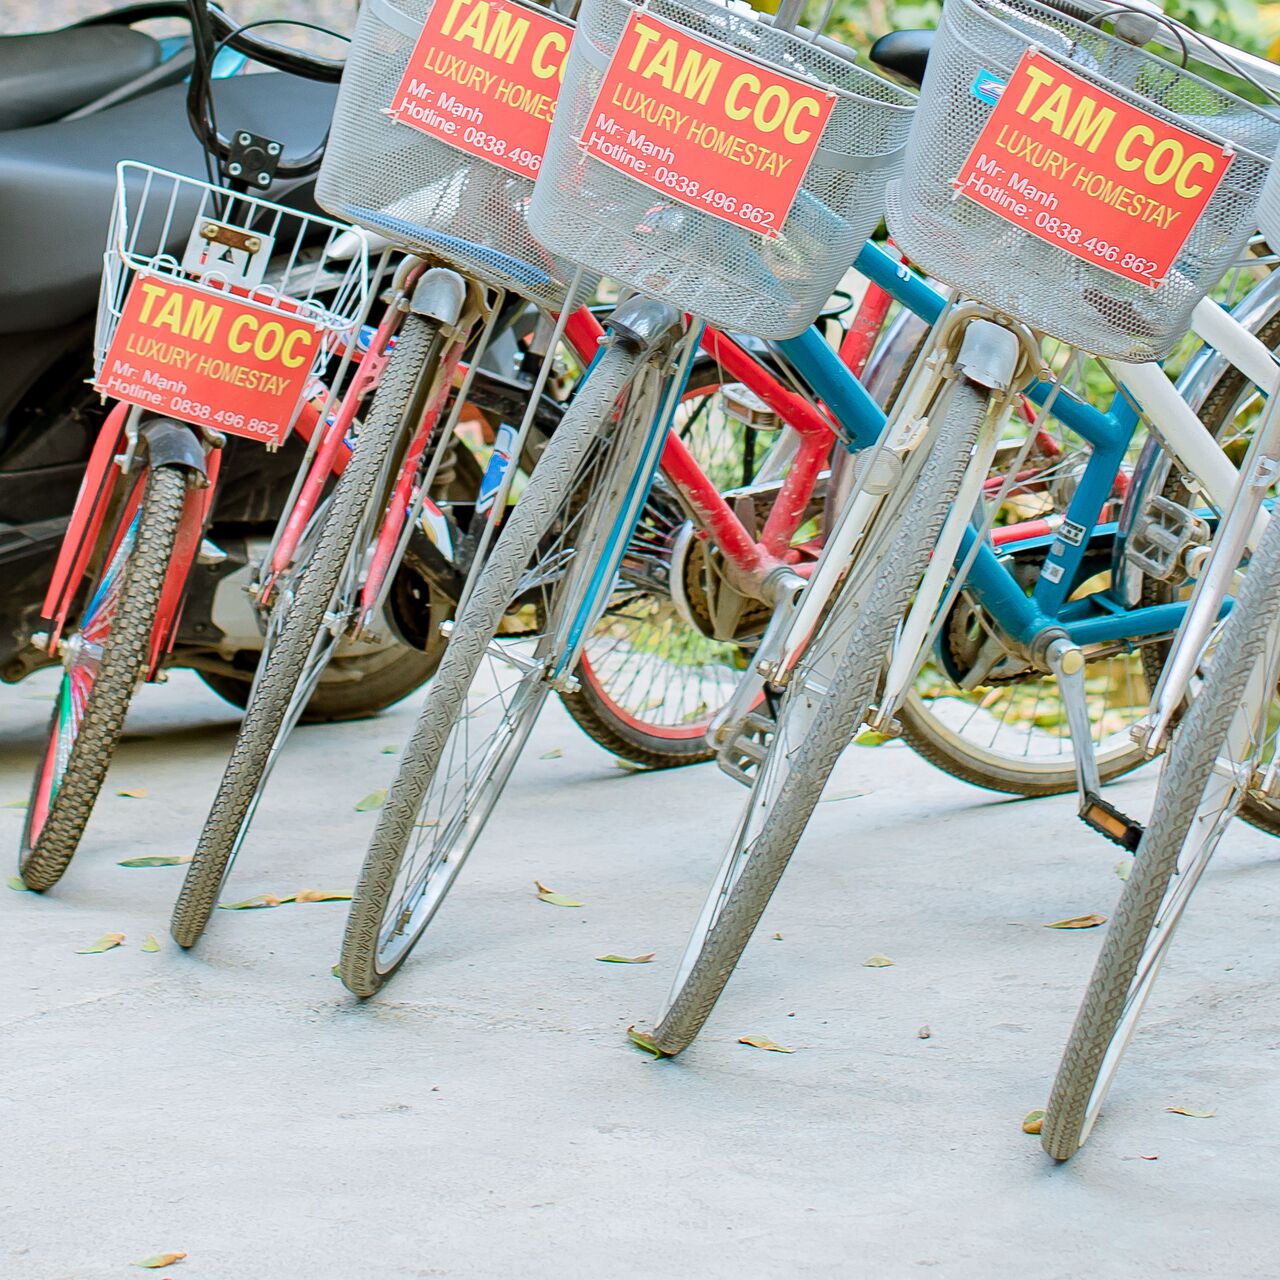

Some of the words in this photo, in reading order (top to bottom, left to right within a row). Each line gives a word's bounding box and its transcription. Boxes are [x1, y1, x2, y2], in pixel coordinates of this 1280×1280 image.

[424, 47, 498, 93] LUXURY
[532, 32, 571, 87] C
[628, 23, 722, 105] TAM
[725, 74, 820, 144] COC
[400, 98, 460, 136] Hotline:
[437, 92, 483, 124] Mạnh
[612, 83, 689, 133] LUXURY
[686, 120, 792, 177] HOMESTAY
[1016, 65, 1116, 153] TAM
[1116, 125, 1214, 198] COC
[626, 130, 674, 164] Mạnh
[996, 125, 1077, 179] LUXURY
[1072, 167, 1180, 229] HOMESTAY
[586, 132, 651, 175] Hotline:
[652, 167, 774, 228] 0838.496.862
[1008, 173, 1058, 210] Mạnh
[966, 173, 1032, 219] Hotline:
[1036, 212, 1157, 279] 0838.496.862
[139, 283, 223, 345] TAM
[228, 314, 313, 368] COC
[126, 334, 197, 369] LUXURY
[196, 356, 290, 395] HOMESTAY
[142, 370, 187, 394] Mạnh
[106, 376, 166, 405] Hotline:
[170, 397, 279, 438] 0838.496.862
